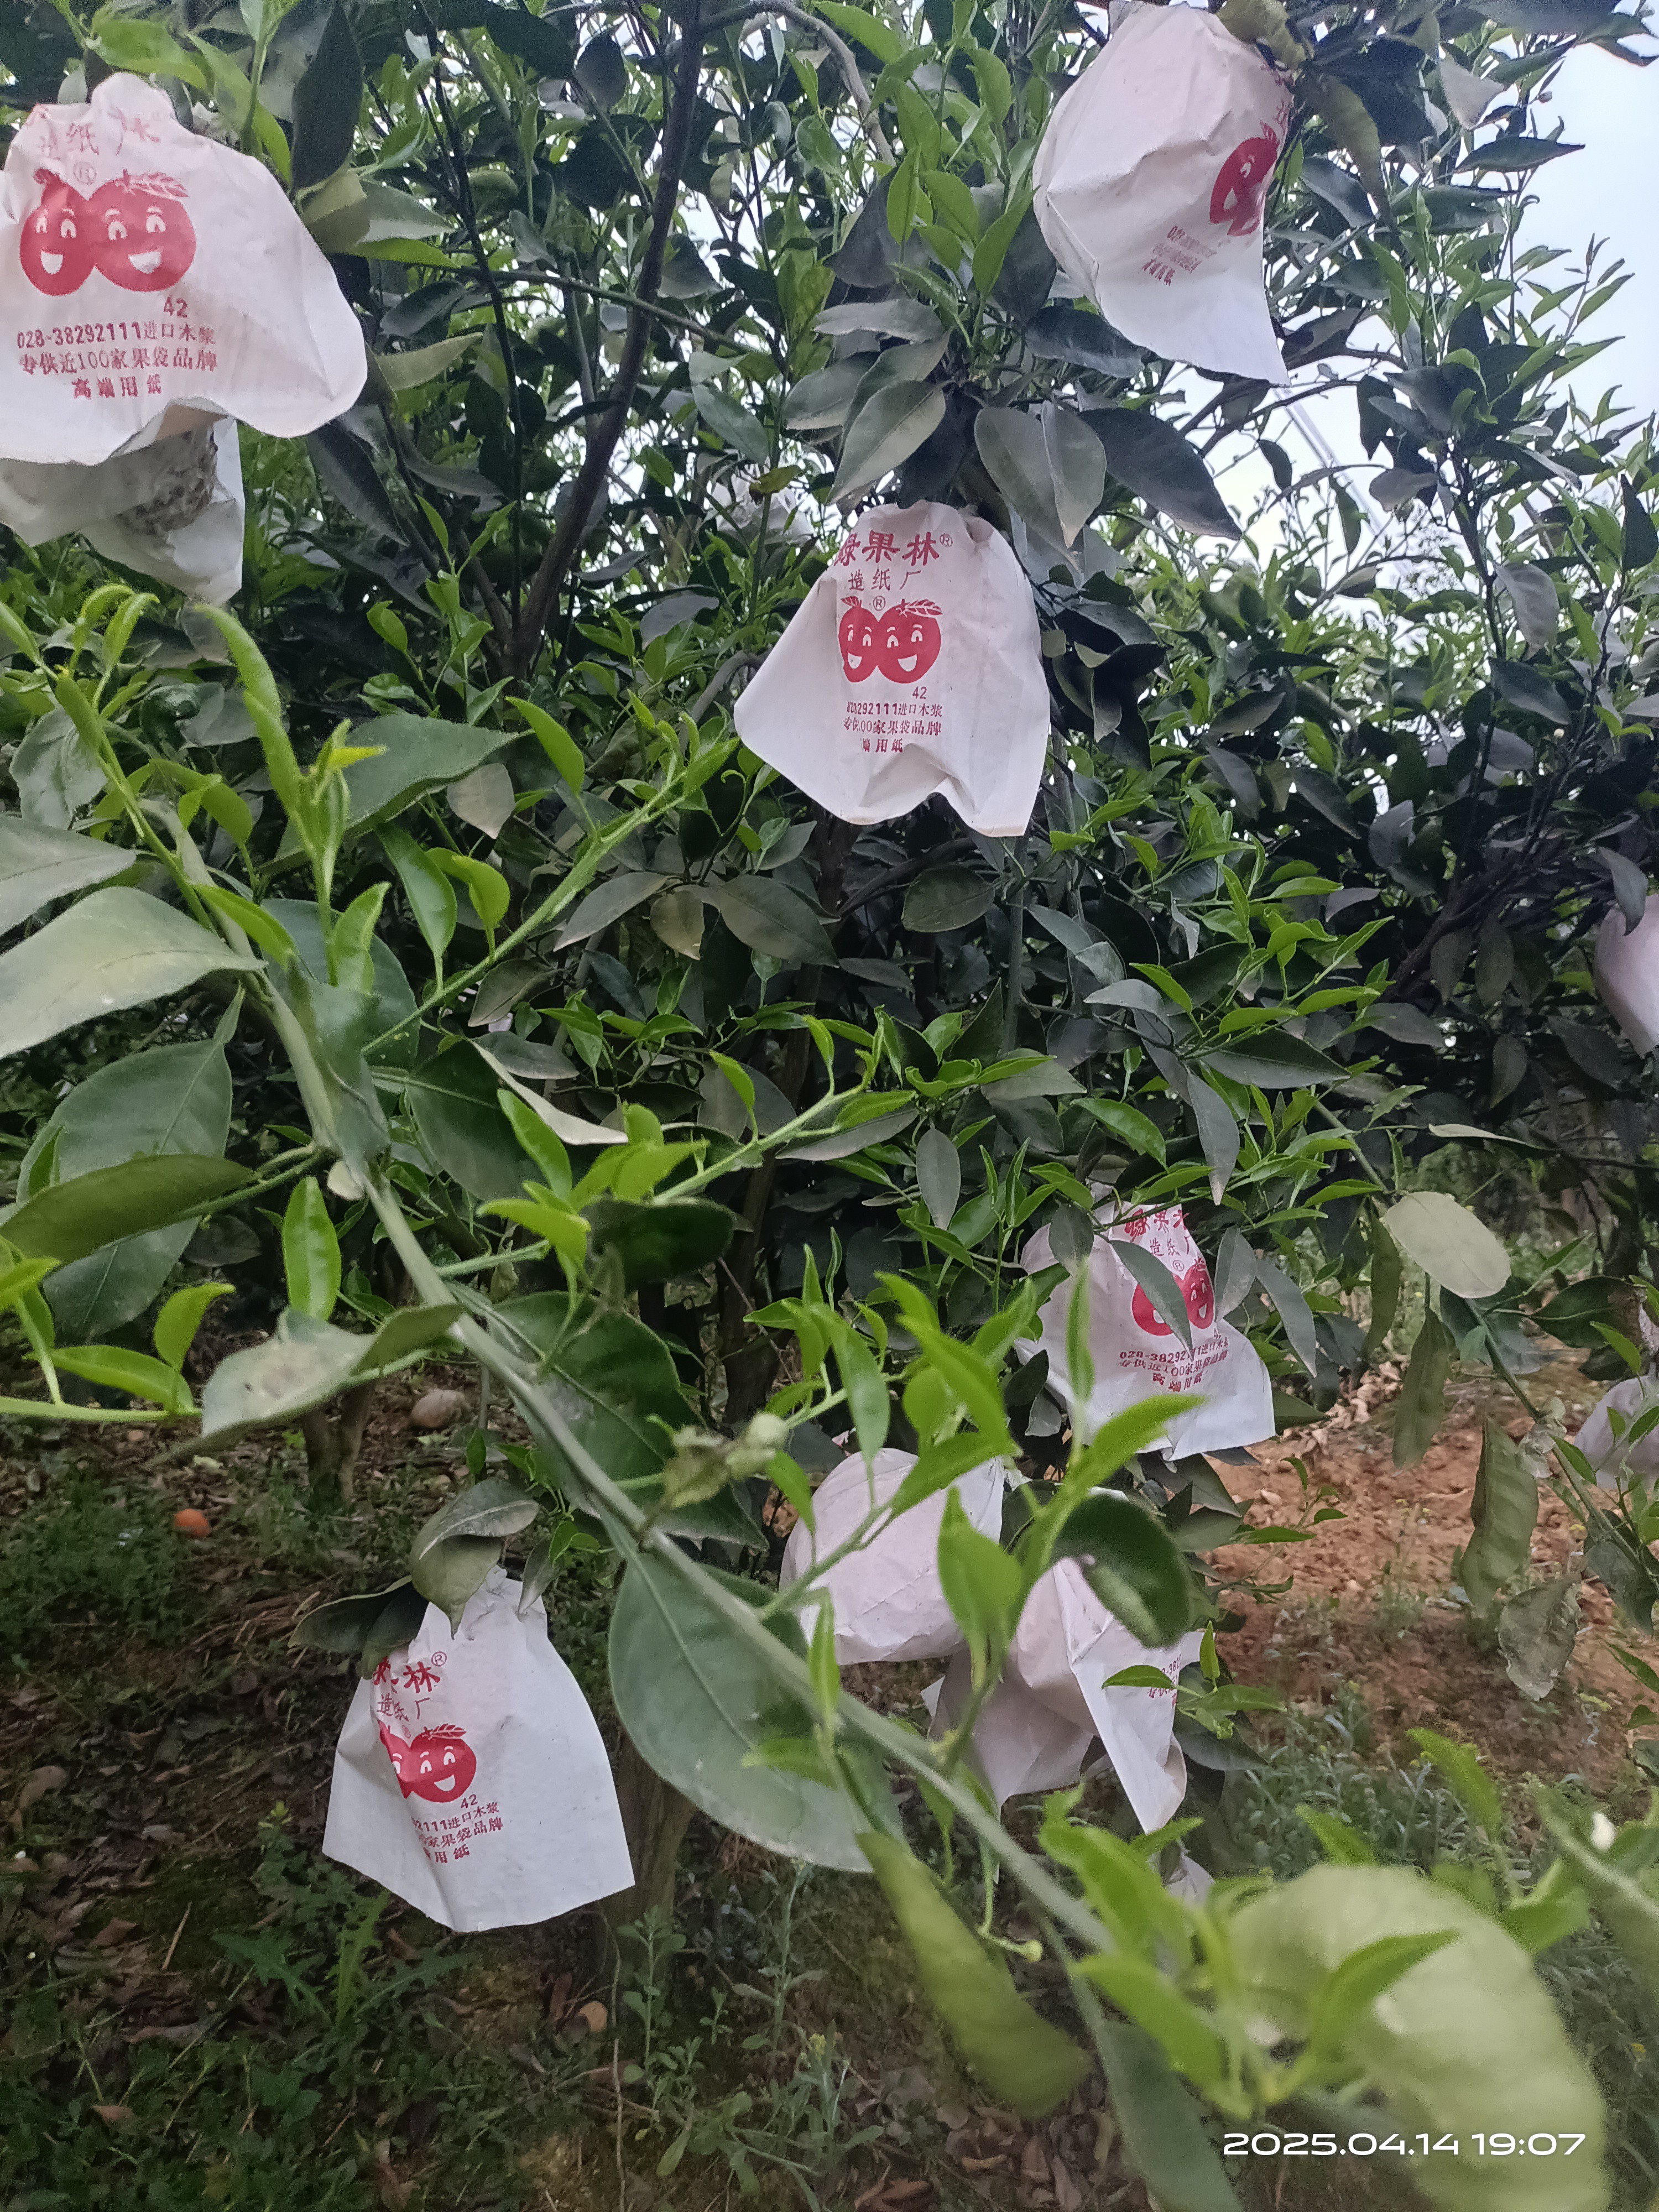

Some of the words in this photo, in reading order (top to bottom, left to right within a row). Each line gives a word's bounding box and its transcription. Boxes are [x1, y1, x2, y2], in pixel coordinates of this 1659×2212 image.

[163, 294, 189, 319] 42
[848, 568, 921, 591] 造纸厂
[912, 686, 927, 700] 42
[461, 1793, 478, 1808] 42
